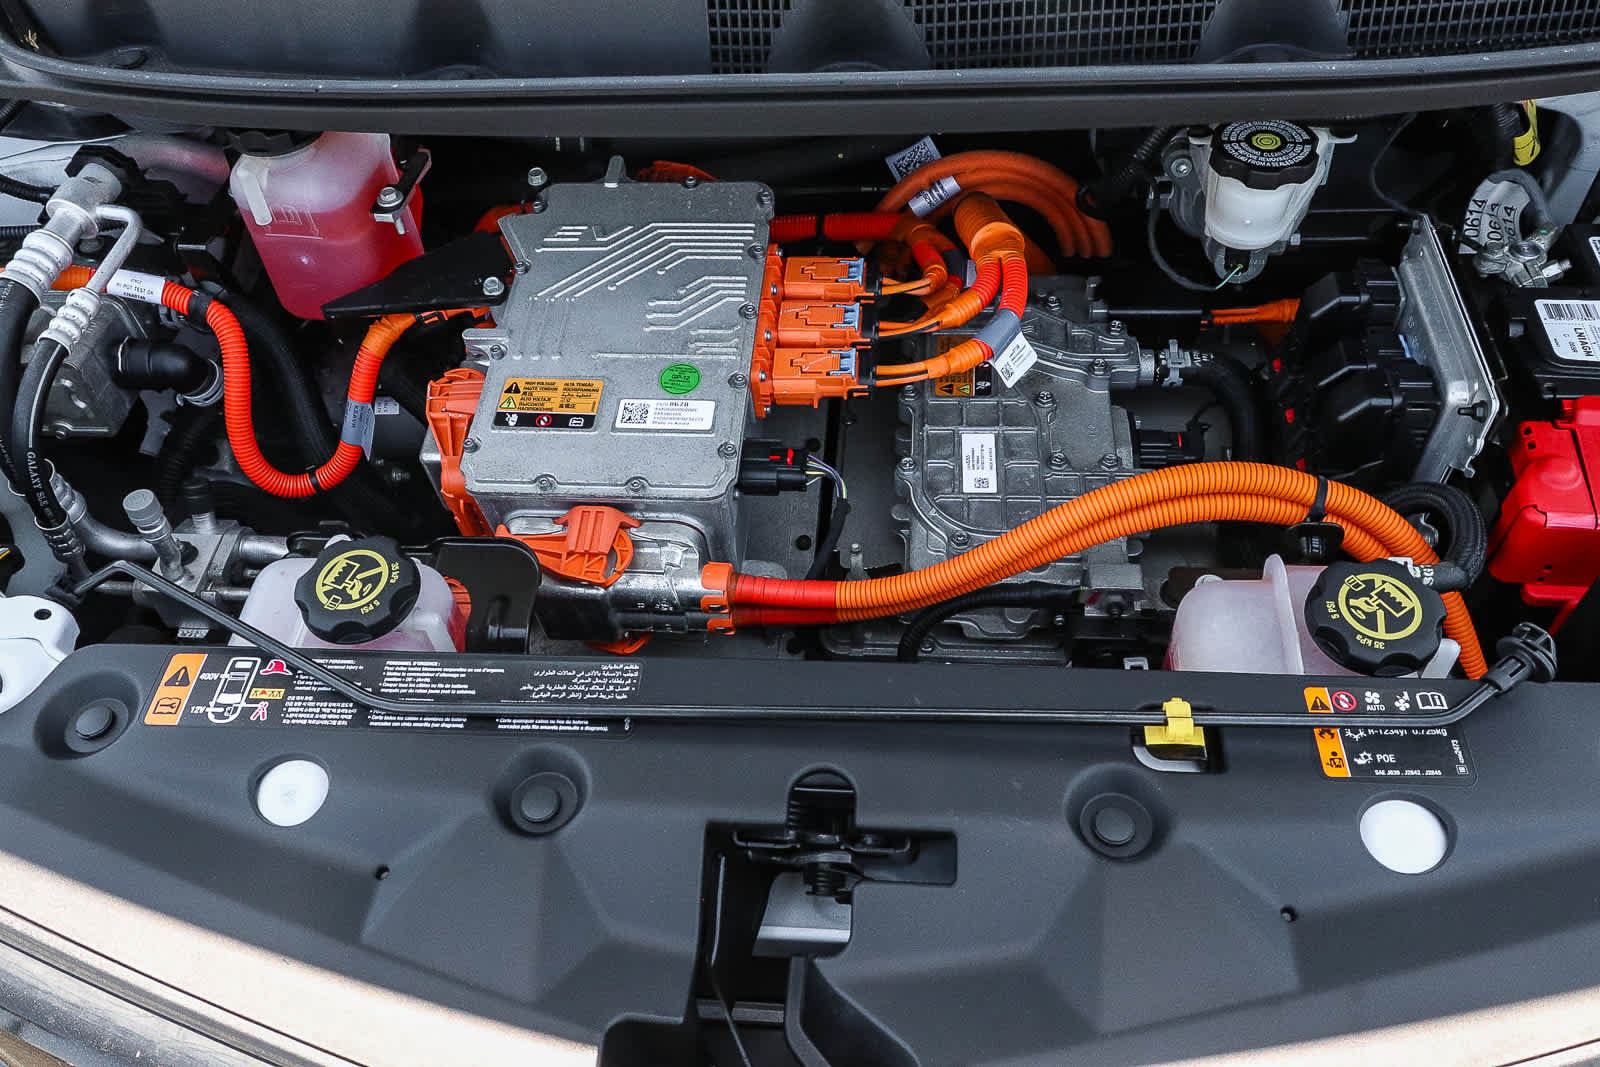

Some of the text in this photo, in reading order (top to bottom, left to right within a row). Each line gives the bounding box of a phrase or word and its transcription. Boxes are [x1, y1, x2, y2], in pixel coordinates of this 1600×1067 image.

[1247, 158, 1265, 166] FROM
[26, 451, 43, 489] GALAXY
[360, 604, 375, 615] PSI
[1325, 600, 1337, 613] PSI
[1355, 634, 1385, 650] 35 kPa
[199, 672, 220, 681] 400V
[190, 705, 206, 714] 12V
[1366, 704, 1386, 712] AUTO
[1376, 753, 1396, 763] POE
